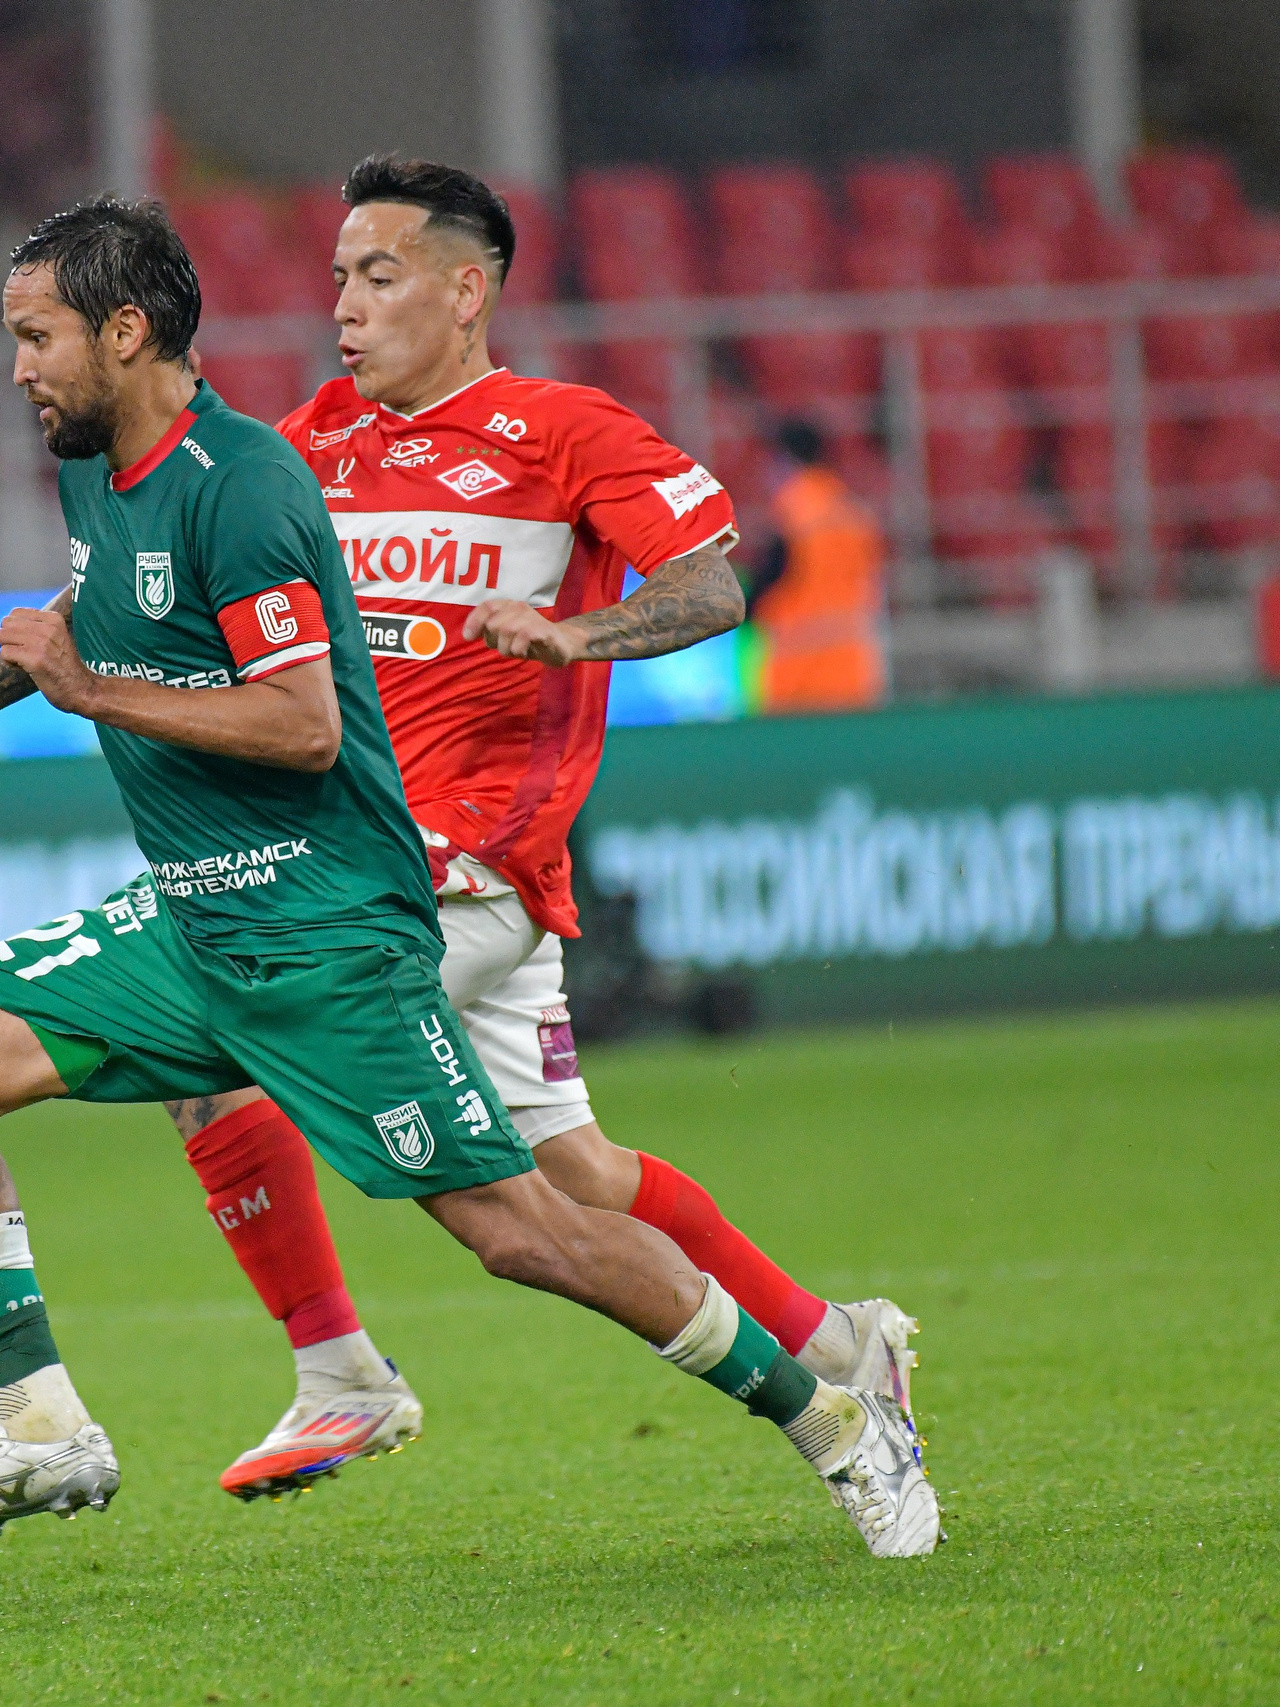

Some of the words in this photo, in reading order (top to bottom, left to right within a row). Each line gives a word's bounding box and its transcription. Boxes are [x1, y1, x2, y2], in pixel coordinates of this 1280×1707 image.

[700, 472, 714, 484] Б
[321, 486, 354, 498] ÖGEL
[138, 555, 169, 564] РУБИН
[376, 1104, 418, 1126] РУБИН
[209, 1186, 271, 1232] СМ
